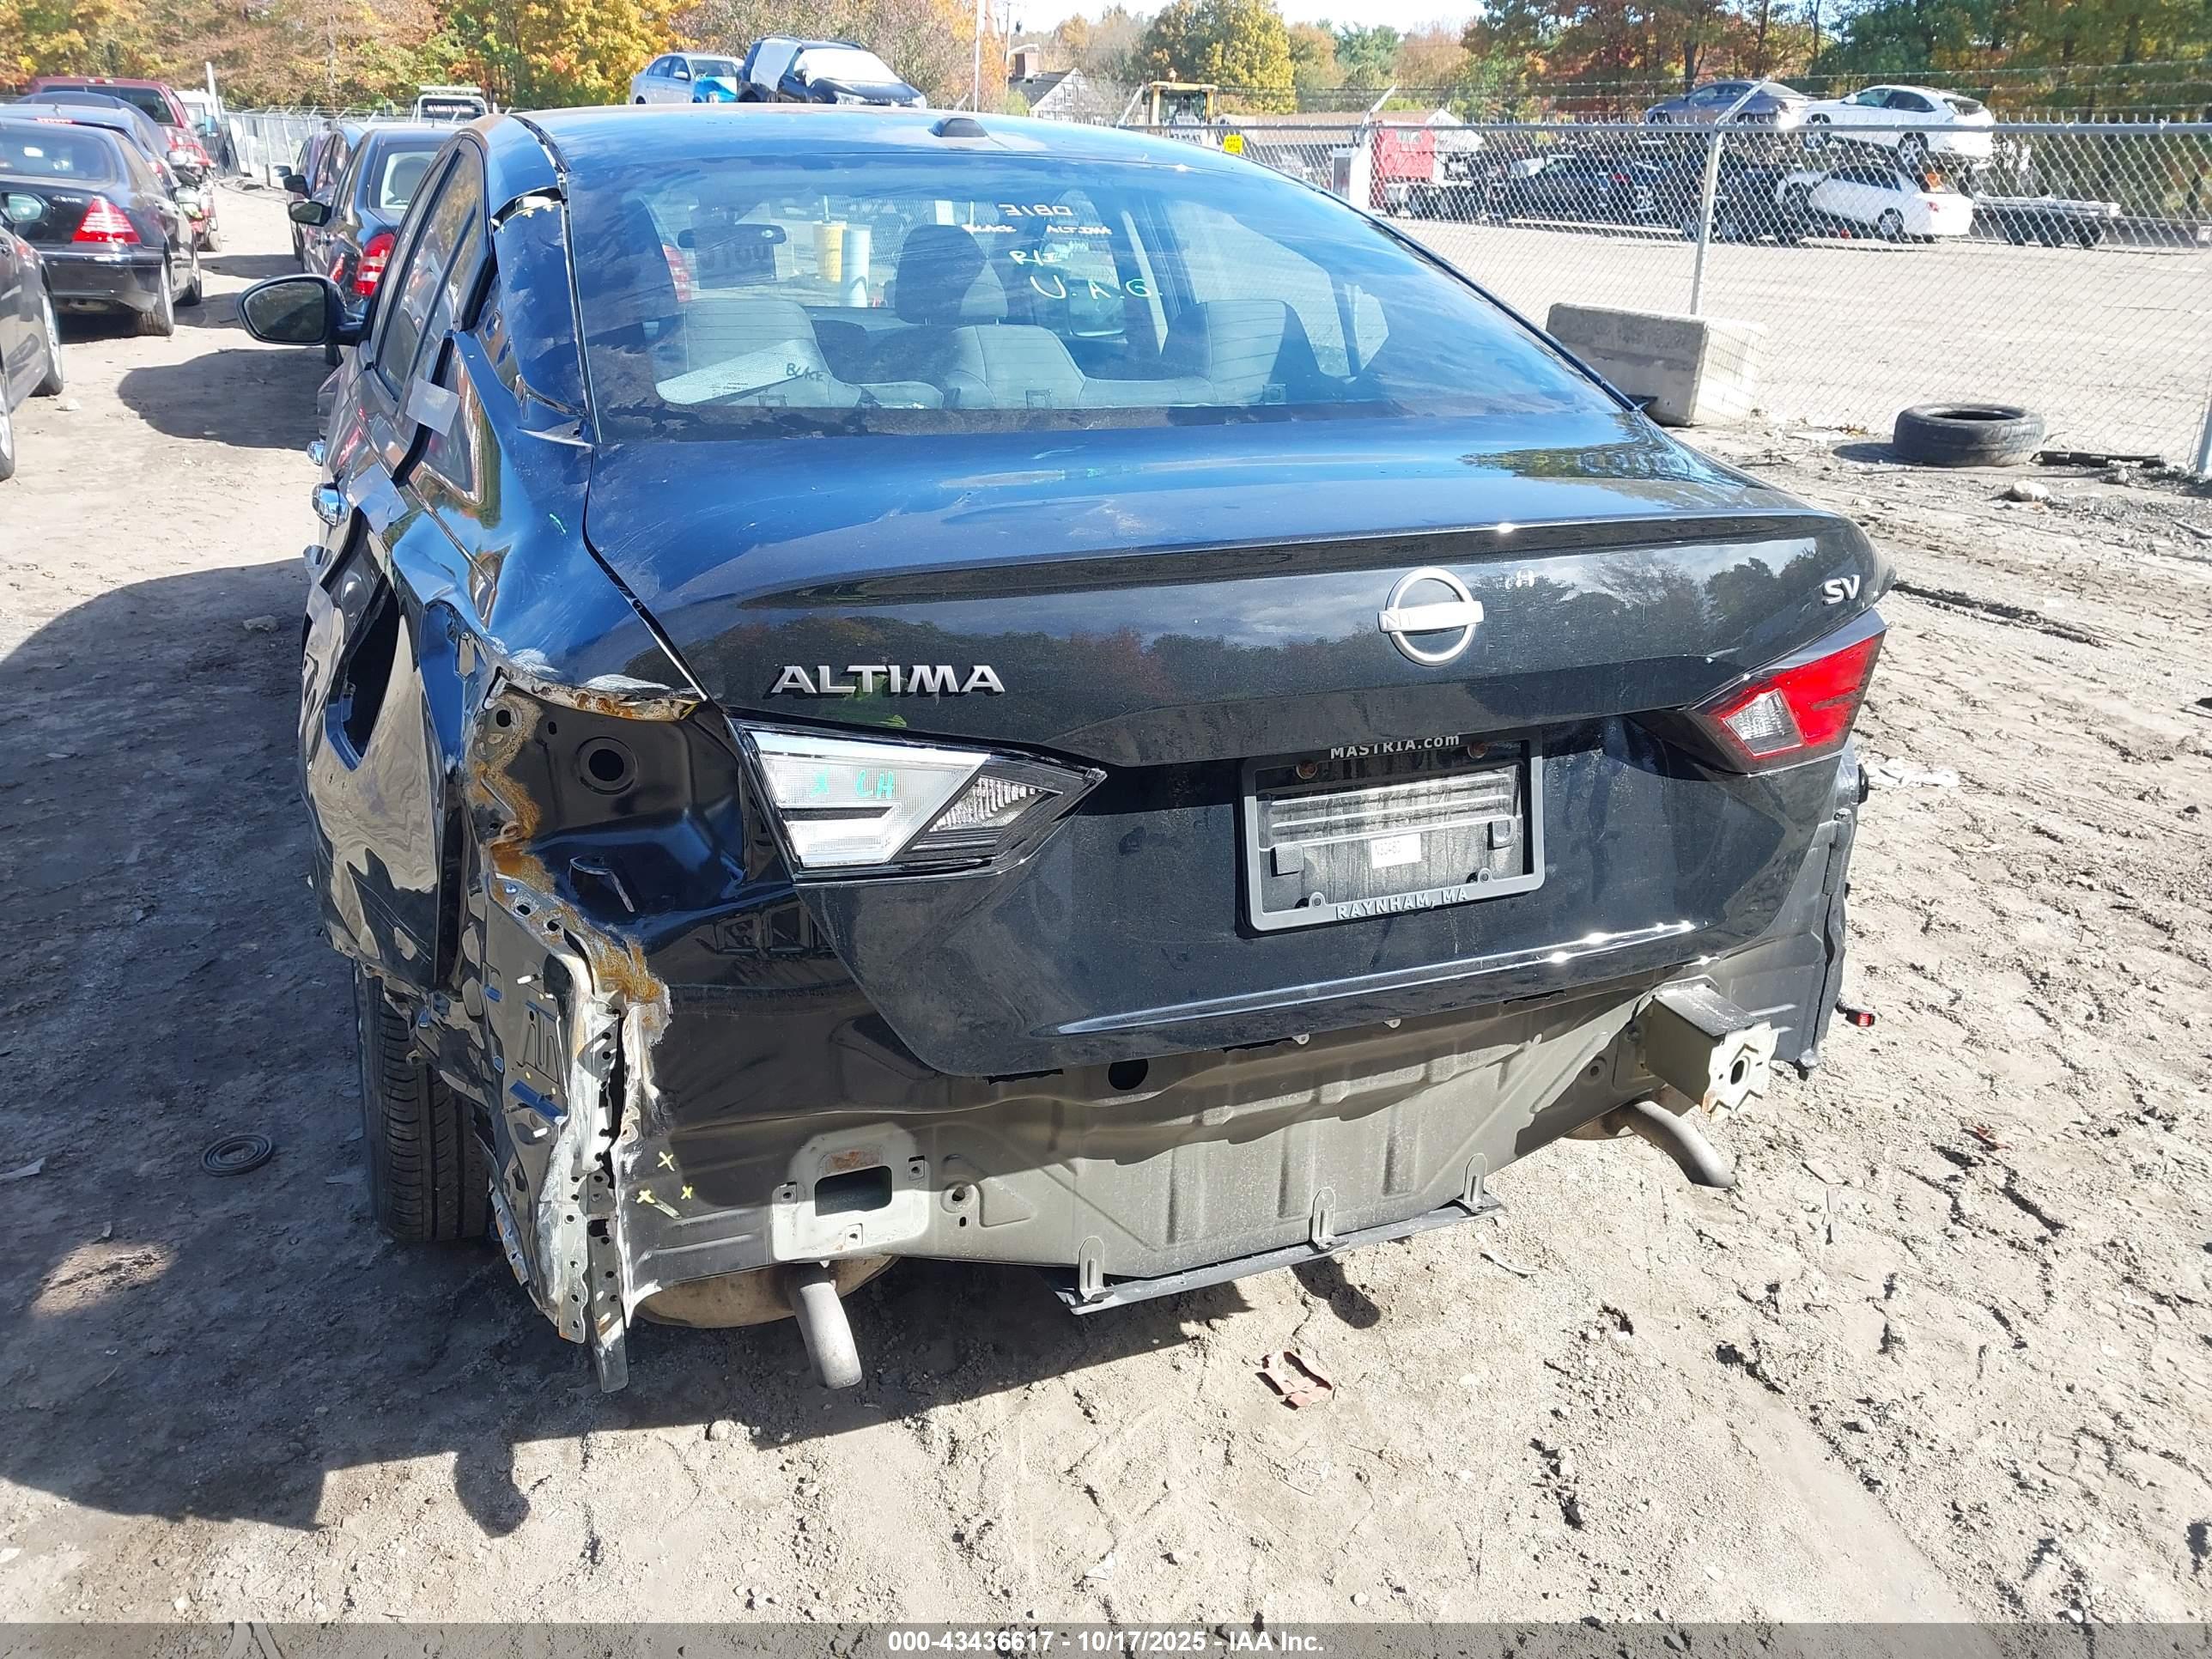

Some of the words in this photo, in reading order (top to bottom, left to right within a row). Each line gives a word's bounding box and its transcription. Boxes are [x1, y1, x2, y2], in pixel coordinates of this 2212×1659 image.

[999, 204, 1073, 216] 3180
[1822, 574, 1861, 605] SV
[771, 665, 1006, 694] ALTIMA
[1330, 734, 1460, 759] MASTRIA.com
[1335, 892, 1436, 919] RAYNHAM,
[1443, 887, 1468, 902] MA
